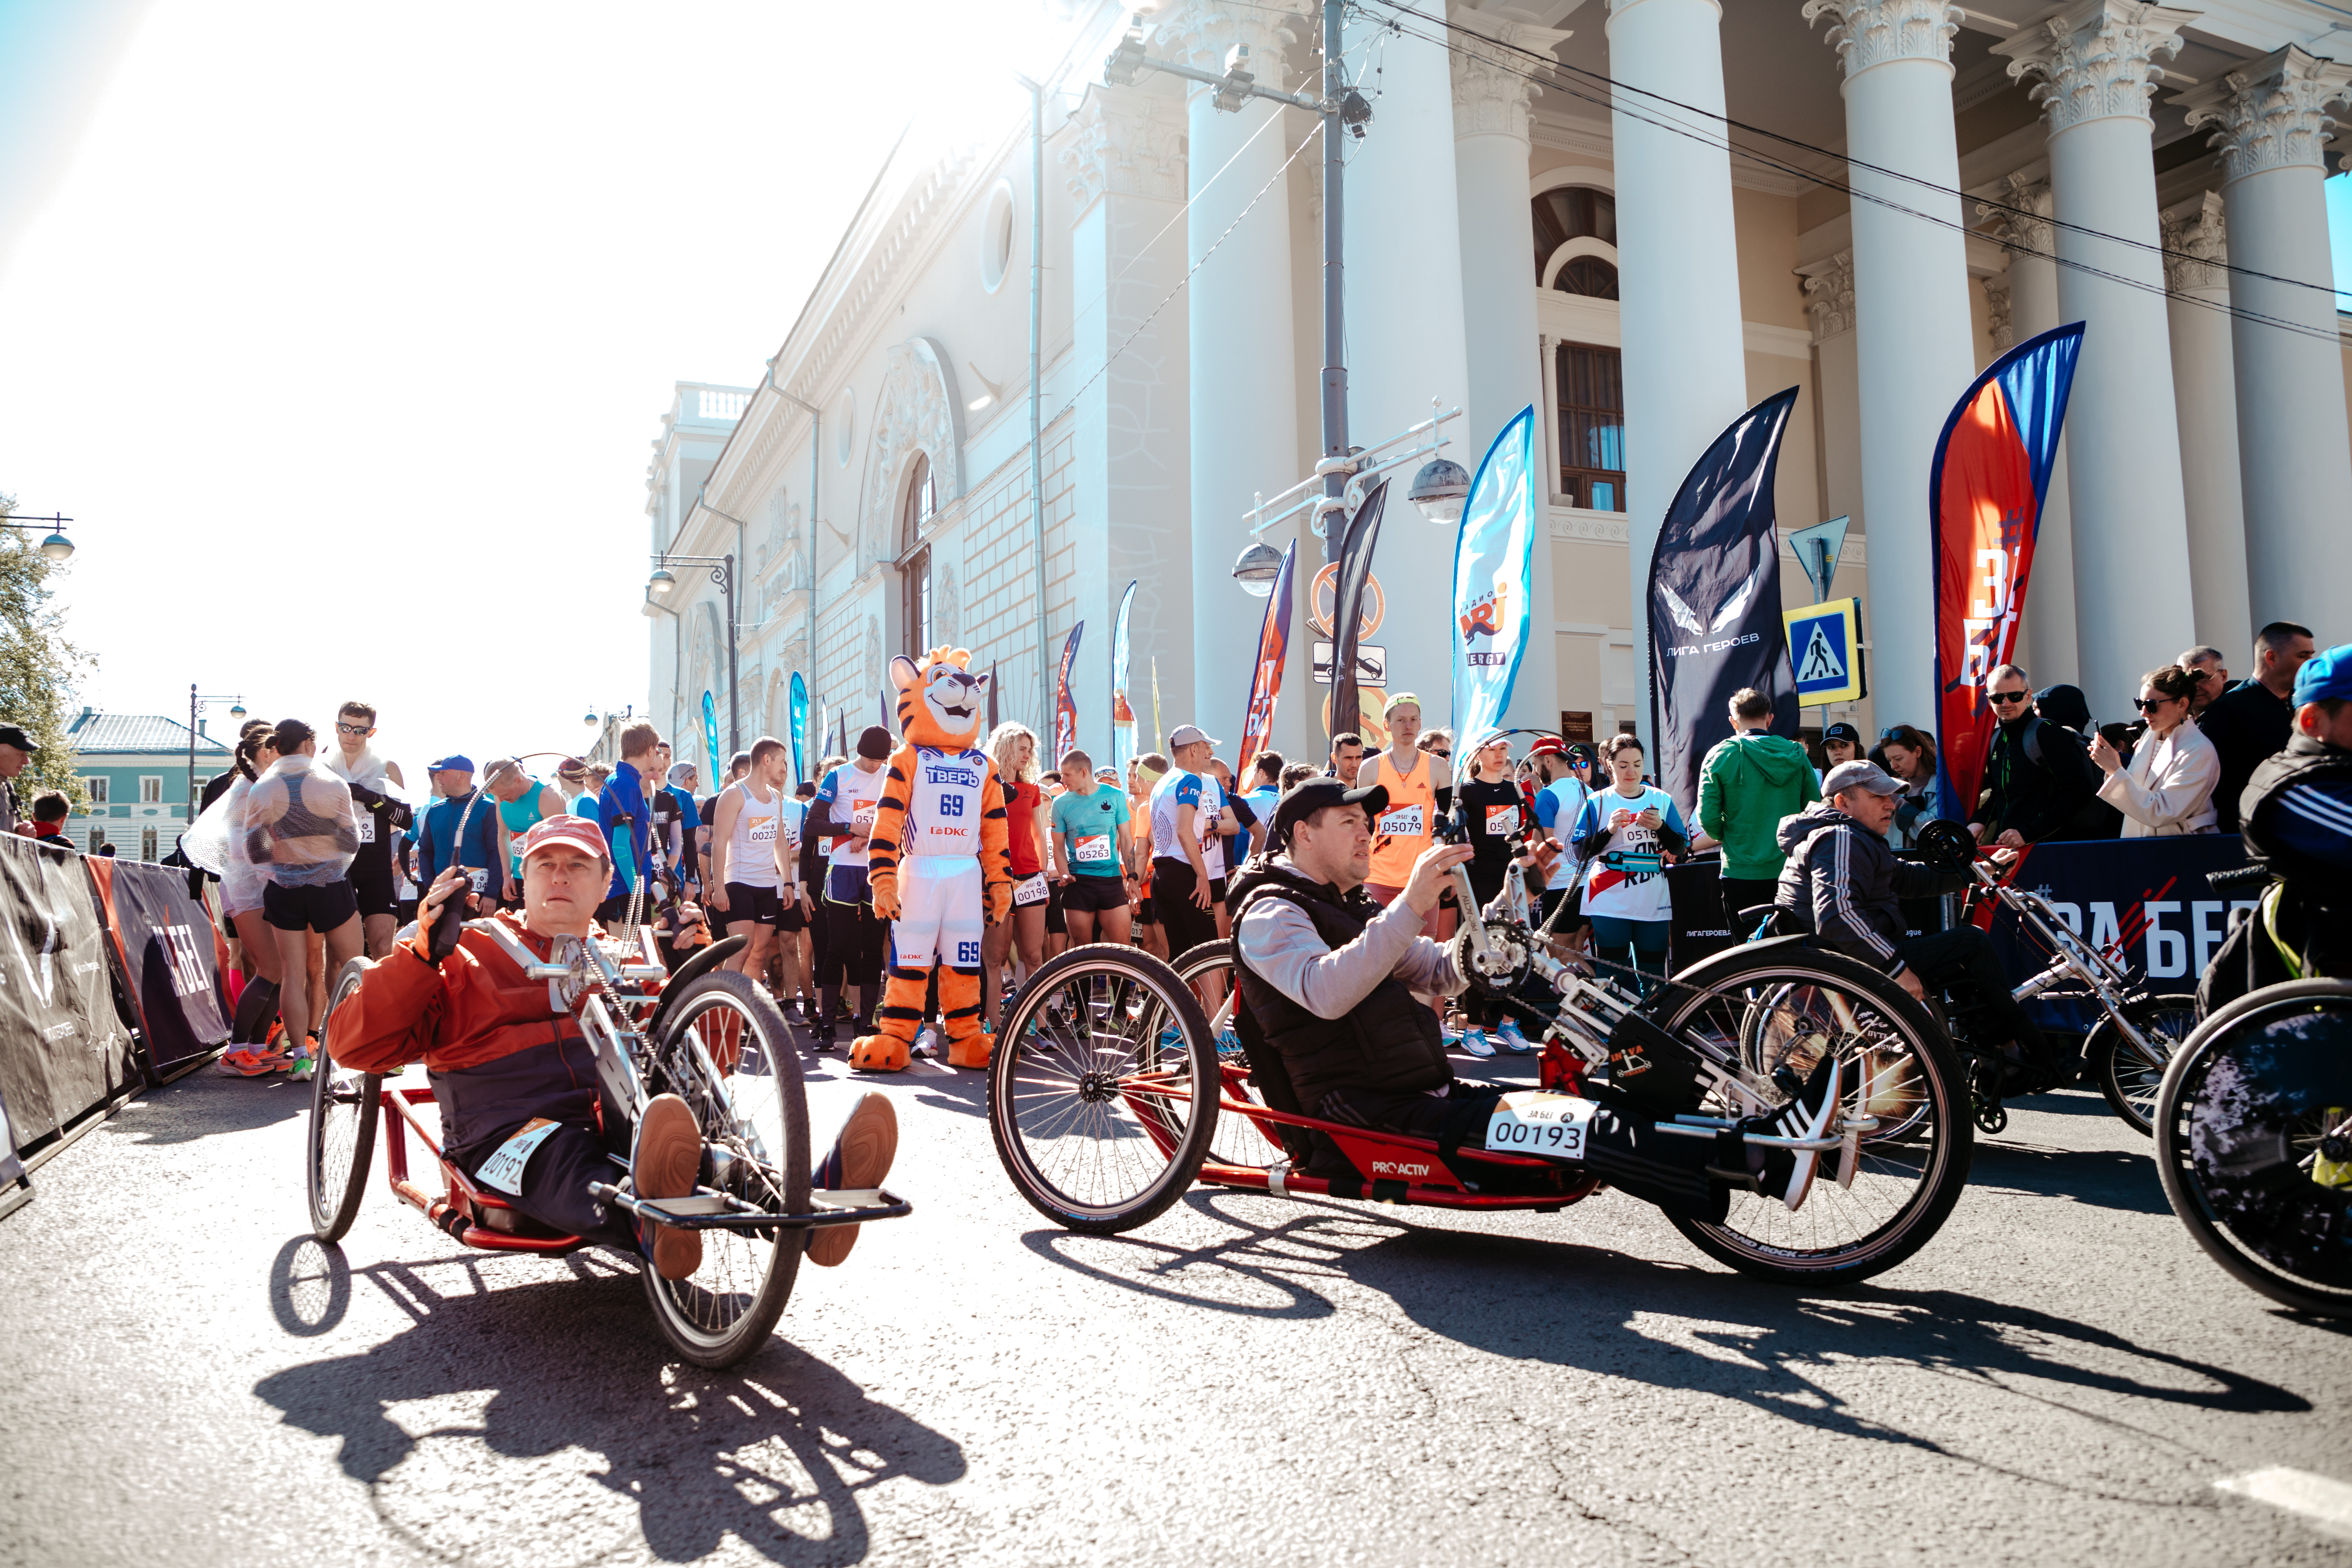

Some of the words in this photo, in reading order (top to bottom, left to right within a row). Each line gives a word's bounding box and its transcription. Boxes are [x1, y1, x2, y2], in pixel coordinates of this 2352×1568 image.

[1460, 591, 1493, 615] РАДИО
[1667, 646, 1700, 657] ЛИГА
[1703, 633, 1760, 653] ГЕРОЕВ
[1467, 652, 1504, 665] ERGY
[927, 768, 979, 788] ТВЕРЬ
[1189, 788, 1201, 798] ПС
[940, 794, 964, 817] 69
[1205, 805, 1218, 813] 138
[856, 815, 874, 824] 051
[944, 827, 968, 836] DKC
[1384, 822, 1422, 832] 05079
[753, 830, 776, 840] 00223
[1574, 829, 1586, 837] СБ
[1627, 829, 1657, 841] 0516
[513, 846, 525, 854] 050
[1079, 849, 1109, 859] 05263
[1018, 887, 1047, 901] 00198
[958, 941, 979, 962] 69
[1495, 1123, 1581, 1149] 00193
[484, 1152, 523, 1185] 00192
[1039, 1197, 1052, 1207] TOUR
[1053, 1207, 1068, 1215] PLUS
[1758, 1243, 1798, 1258] ROCK
